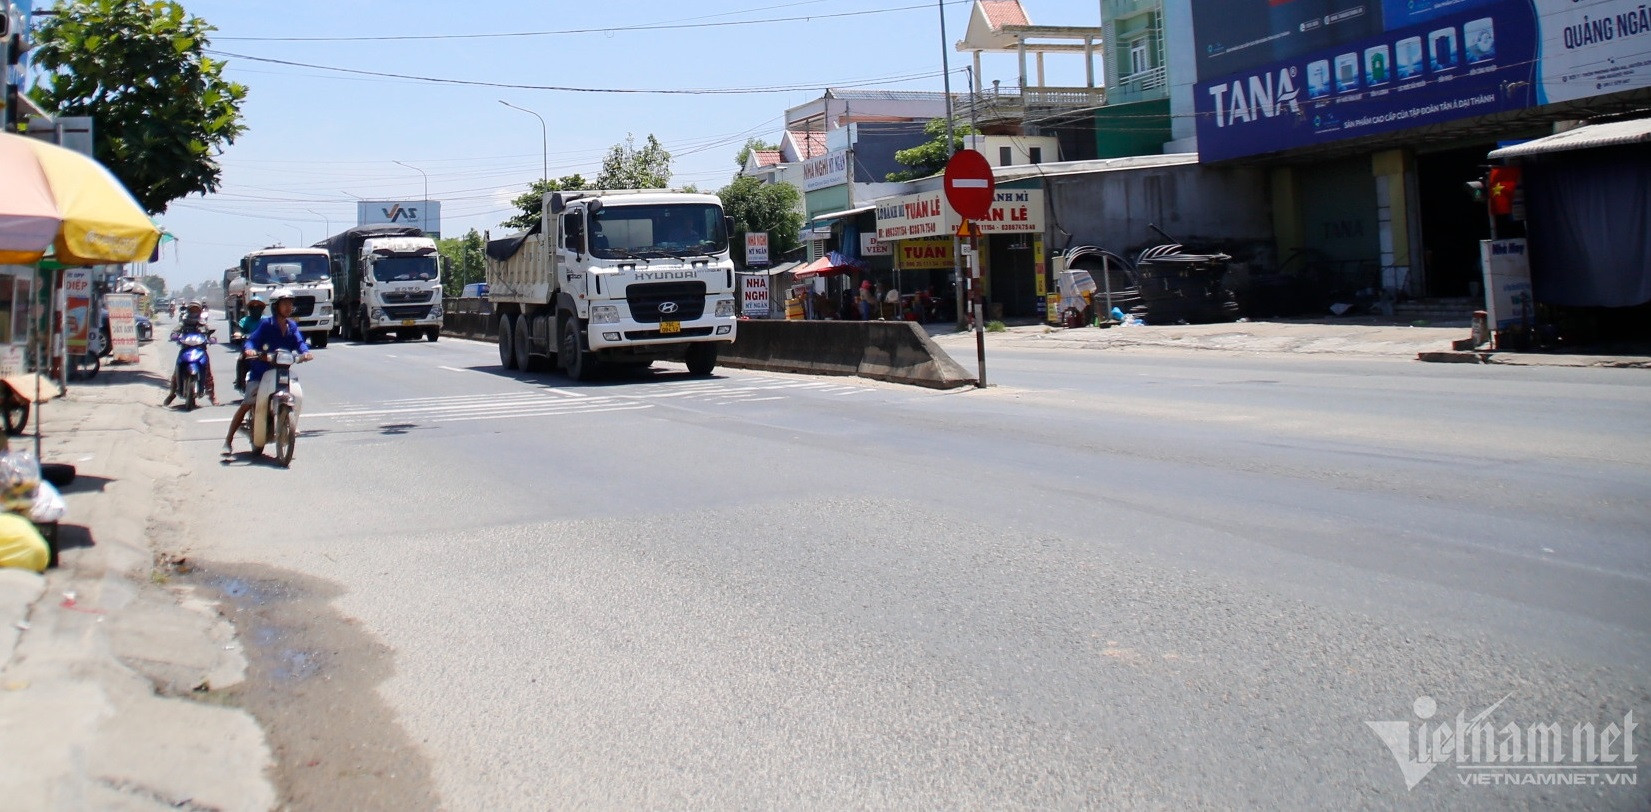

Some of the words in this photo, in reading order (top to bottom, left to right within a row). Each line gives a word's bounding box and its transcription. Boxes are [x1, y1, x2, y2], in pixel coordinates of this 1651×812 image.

[1564, 15, 1613, 49] QUẢNG
[1208, 67, 1300, 127] TANA
[930, 195, 940, 216] LÊ
[1011, 205, 1028, 221] LÊ
[635, 271, 697, 280] HYUNDAI
